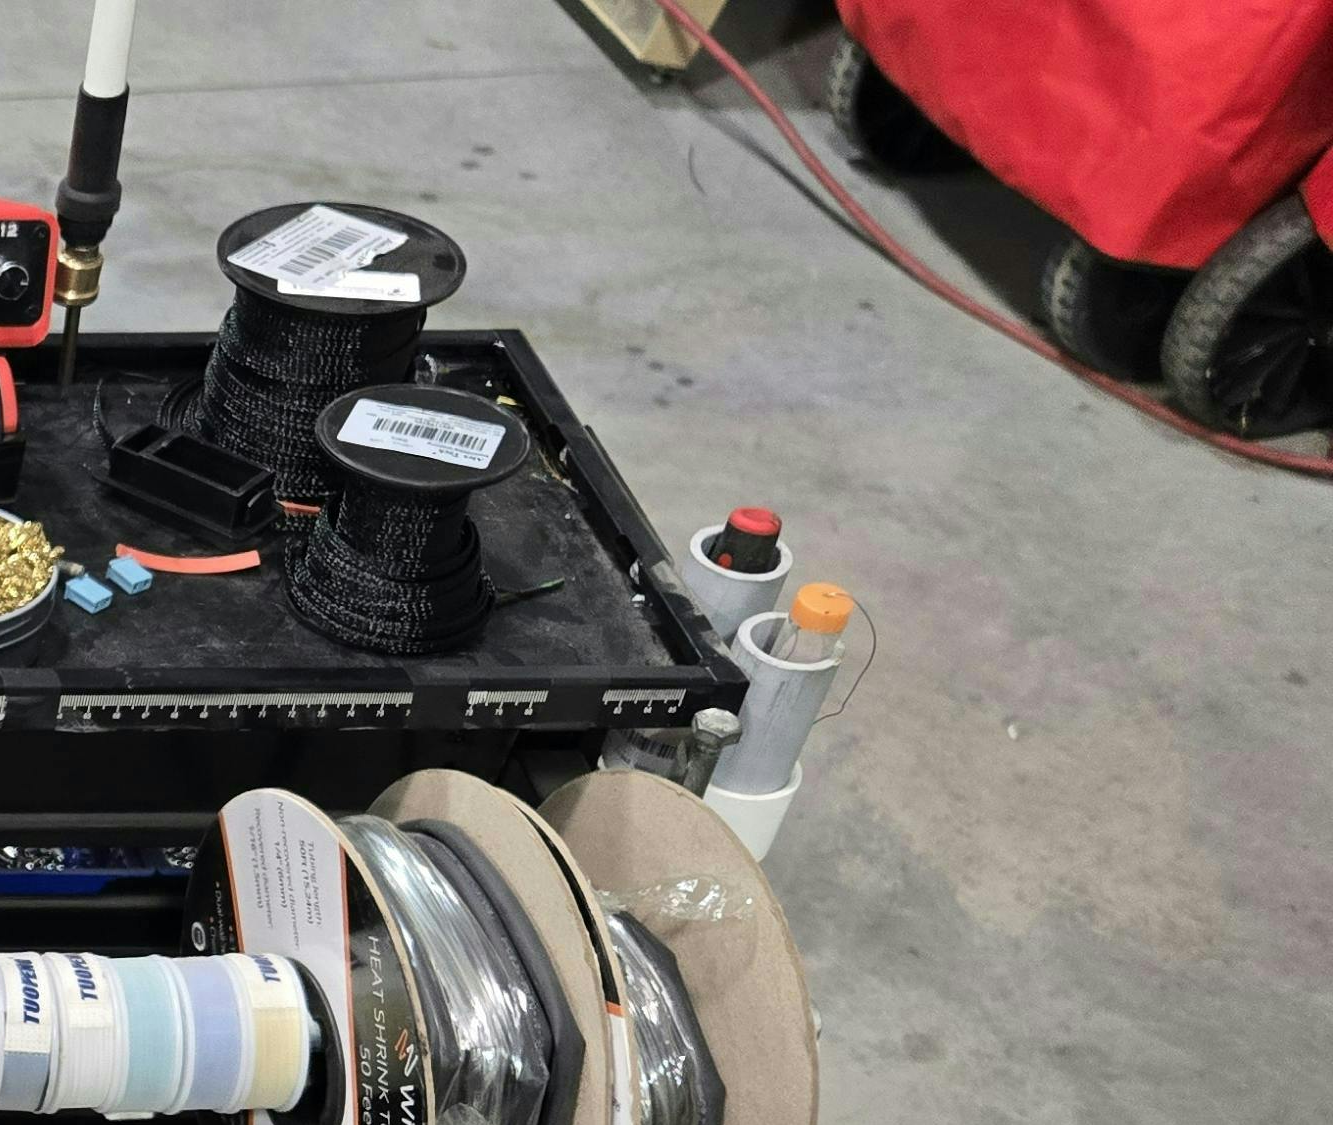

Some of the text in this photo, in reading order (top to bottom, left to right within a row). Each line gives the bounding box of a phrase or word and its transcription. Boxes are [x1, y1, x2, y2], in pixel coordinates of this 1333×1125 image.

[366, 934, 385, 1003] HEAT
[359, 1046, 372, 1078] 50
[371, 1009, 390, 1104] SHRINK
